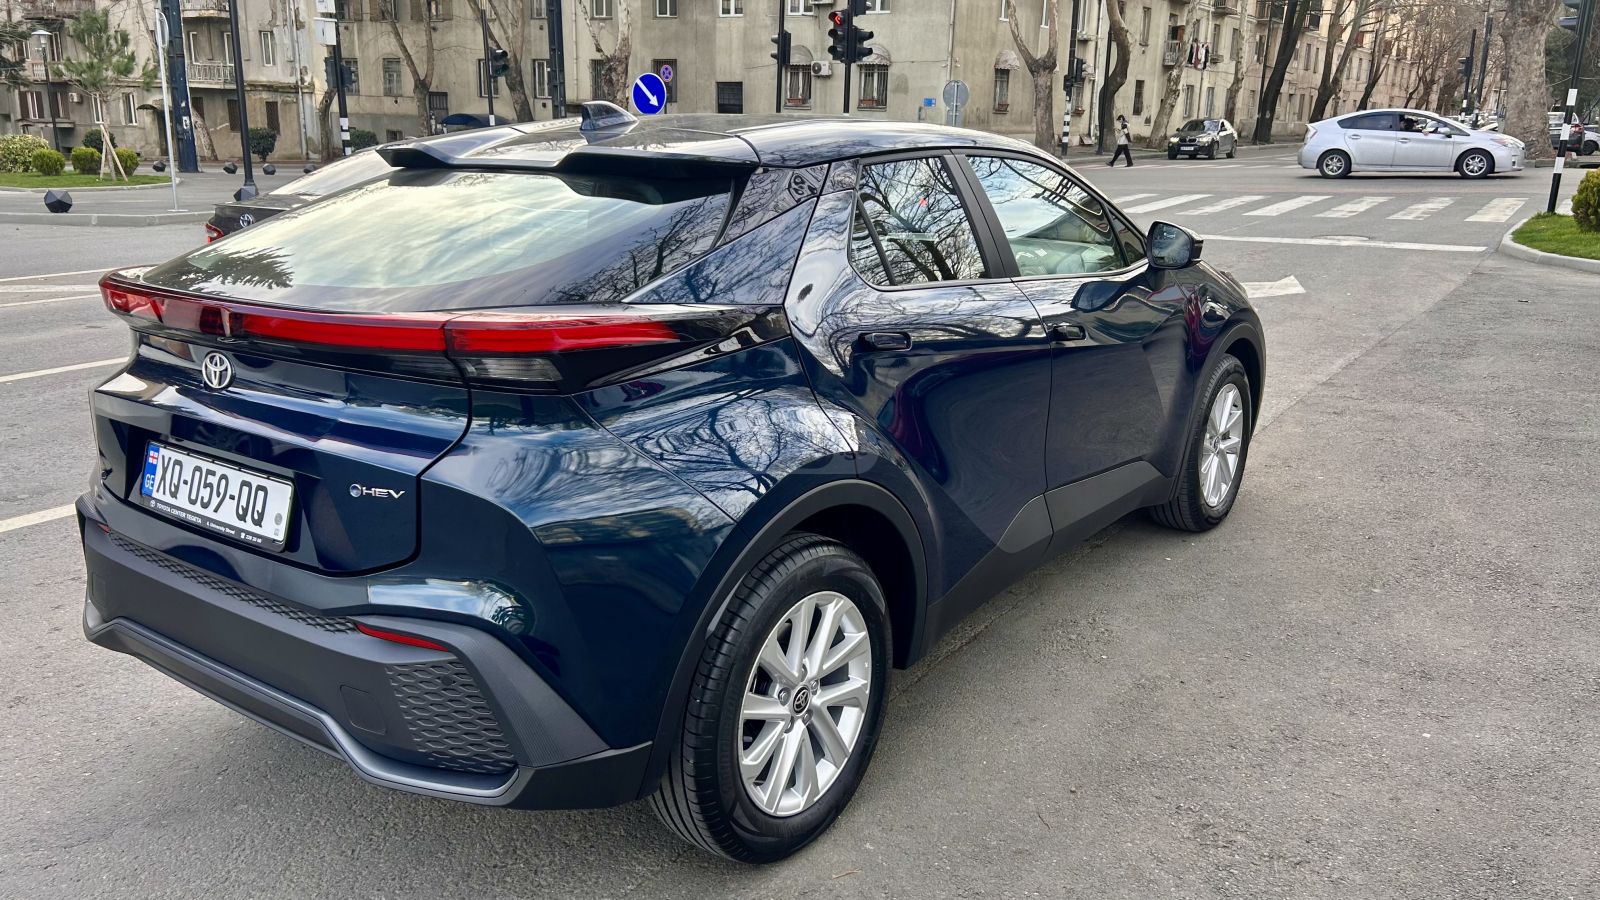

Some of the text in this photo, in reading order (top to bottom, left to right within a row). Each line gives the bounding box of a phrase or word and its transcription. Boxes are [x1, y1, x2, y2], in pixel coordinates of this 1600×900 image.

[145, 473, 155, 490] GE
[156, 455, 269, 528] XQ-059-QQ
[362, 486, 406, 499] HEV
[157, 502, 171, 512] TOYOTA
[170, 508, 186, 518] CENTER
